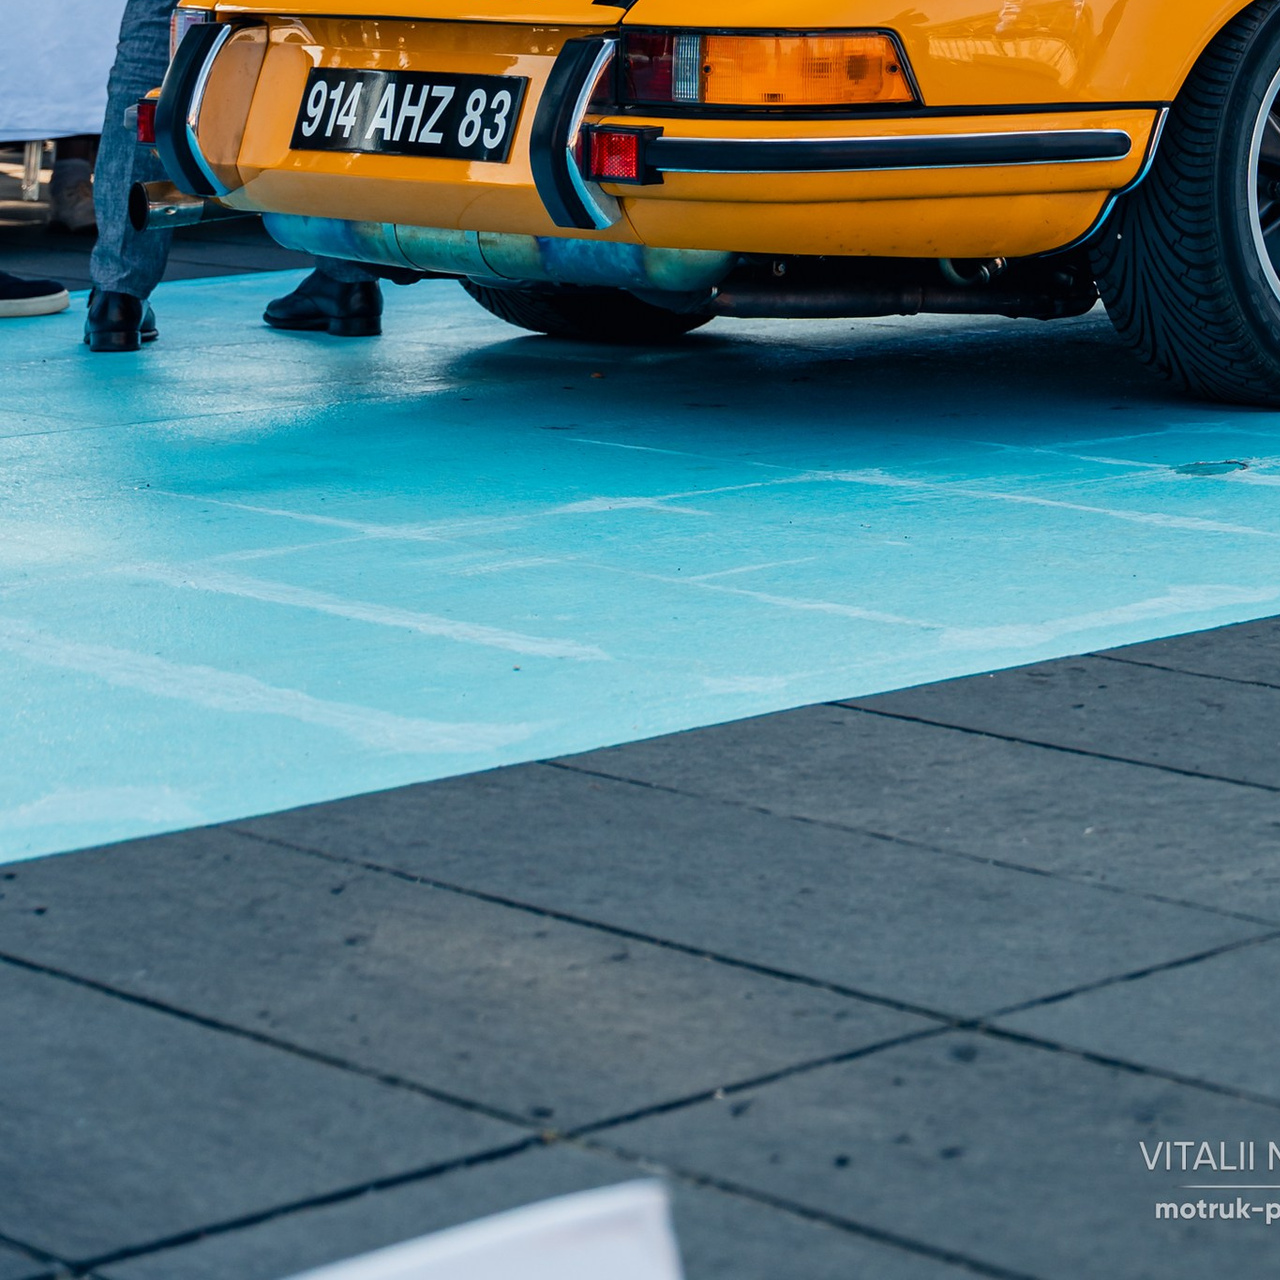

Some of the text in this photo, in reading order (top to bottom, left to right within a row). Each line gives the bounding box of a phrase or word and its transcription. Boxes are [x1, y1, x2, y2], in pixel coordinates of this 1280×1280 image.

[301, 79, 512, 149] 914 AHZ 83
